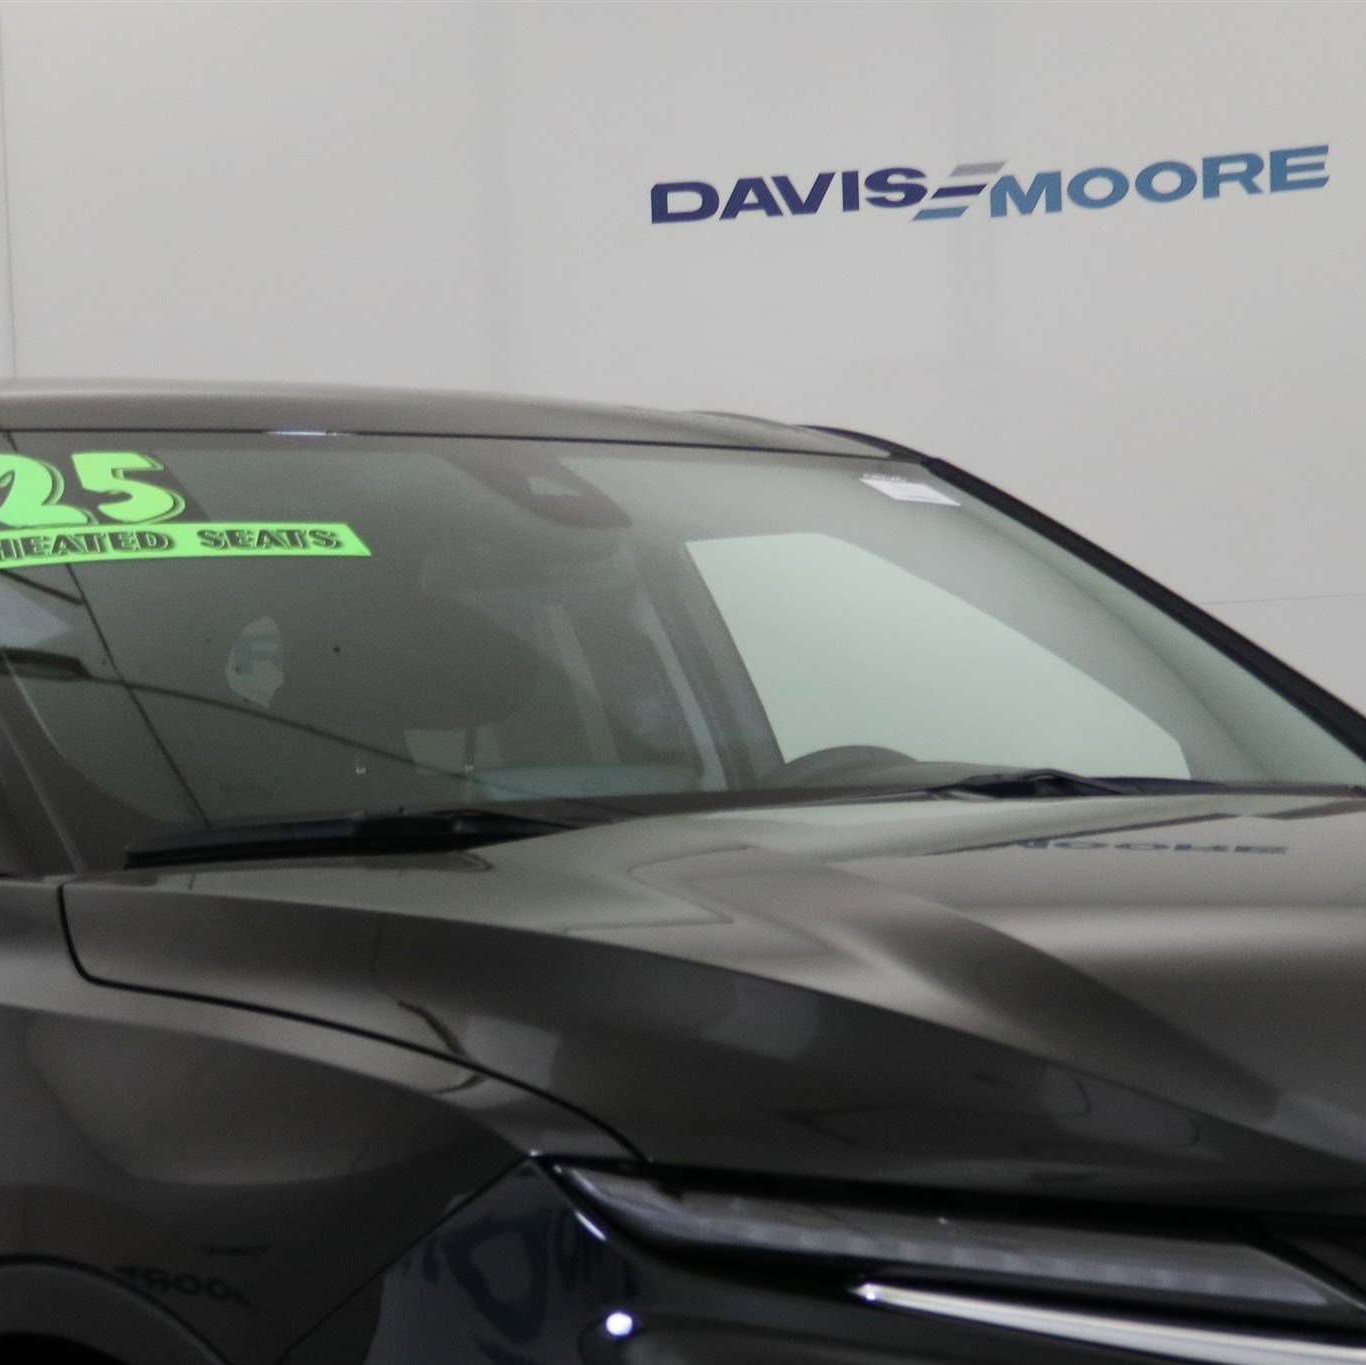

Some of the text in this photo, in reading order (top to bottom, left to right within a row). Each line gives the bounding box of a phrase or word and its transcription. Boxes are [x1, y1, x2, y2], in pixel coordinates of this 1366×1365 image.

[650, 144, 1330, 225] DAVIS MOORE
[197, 529, 342, 550] SEATS
